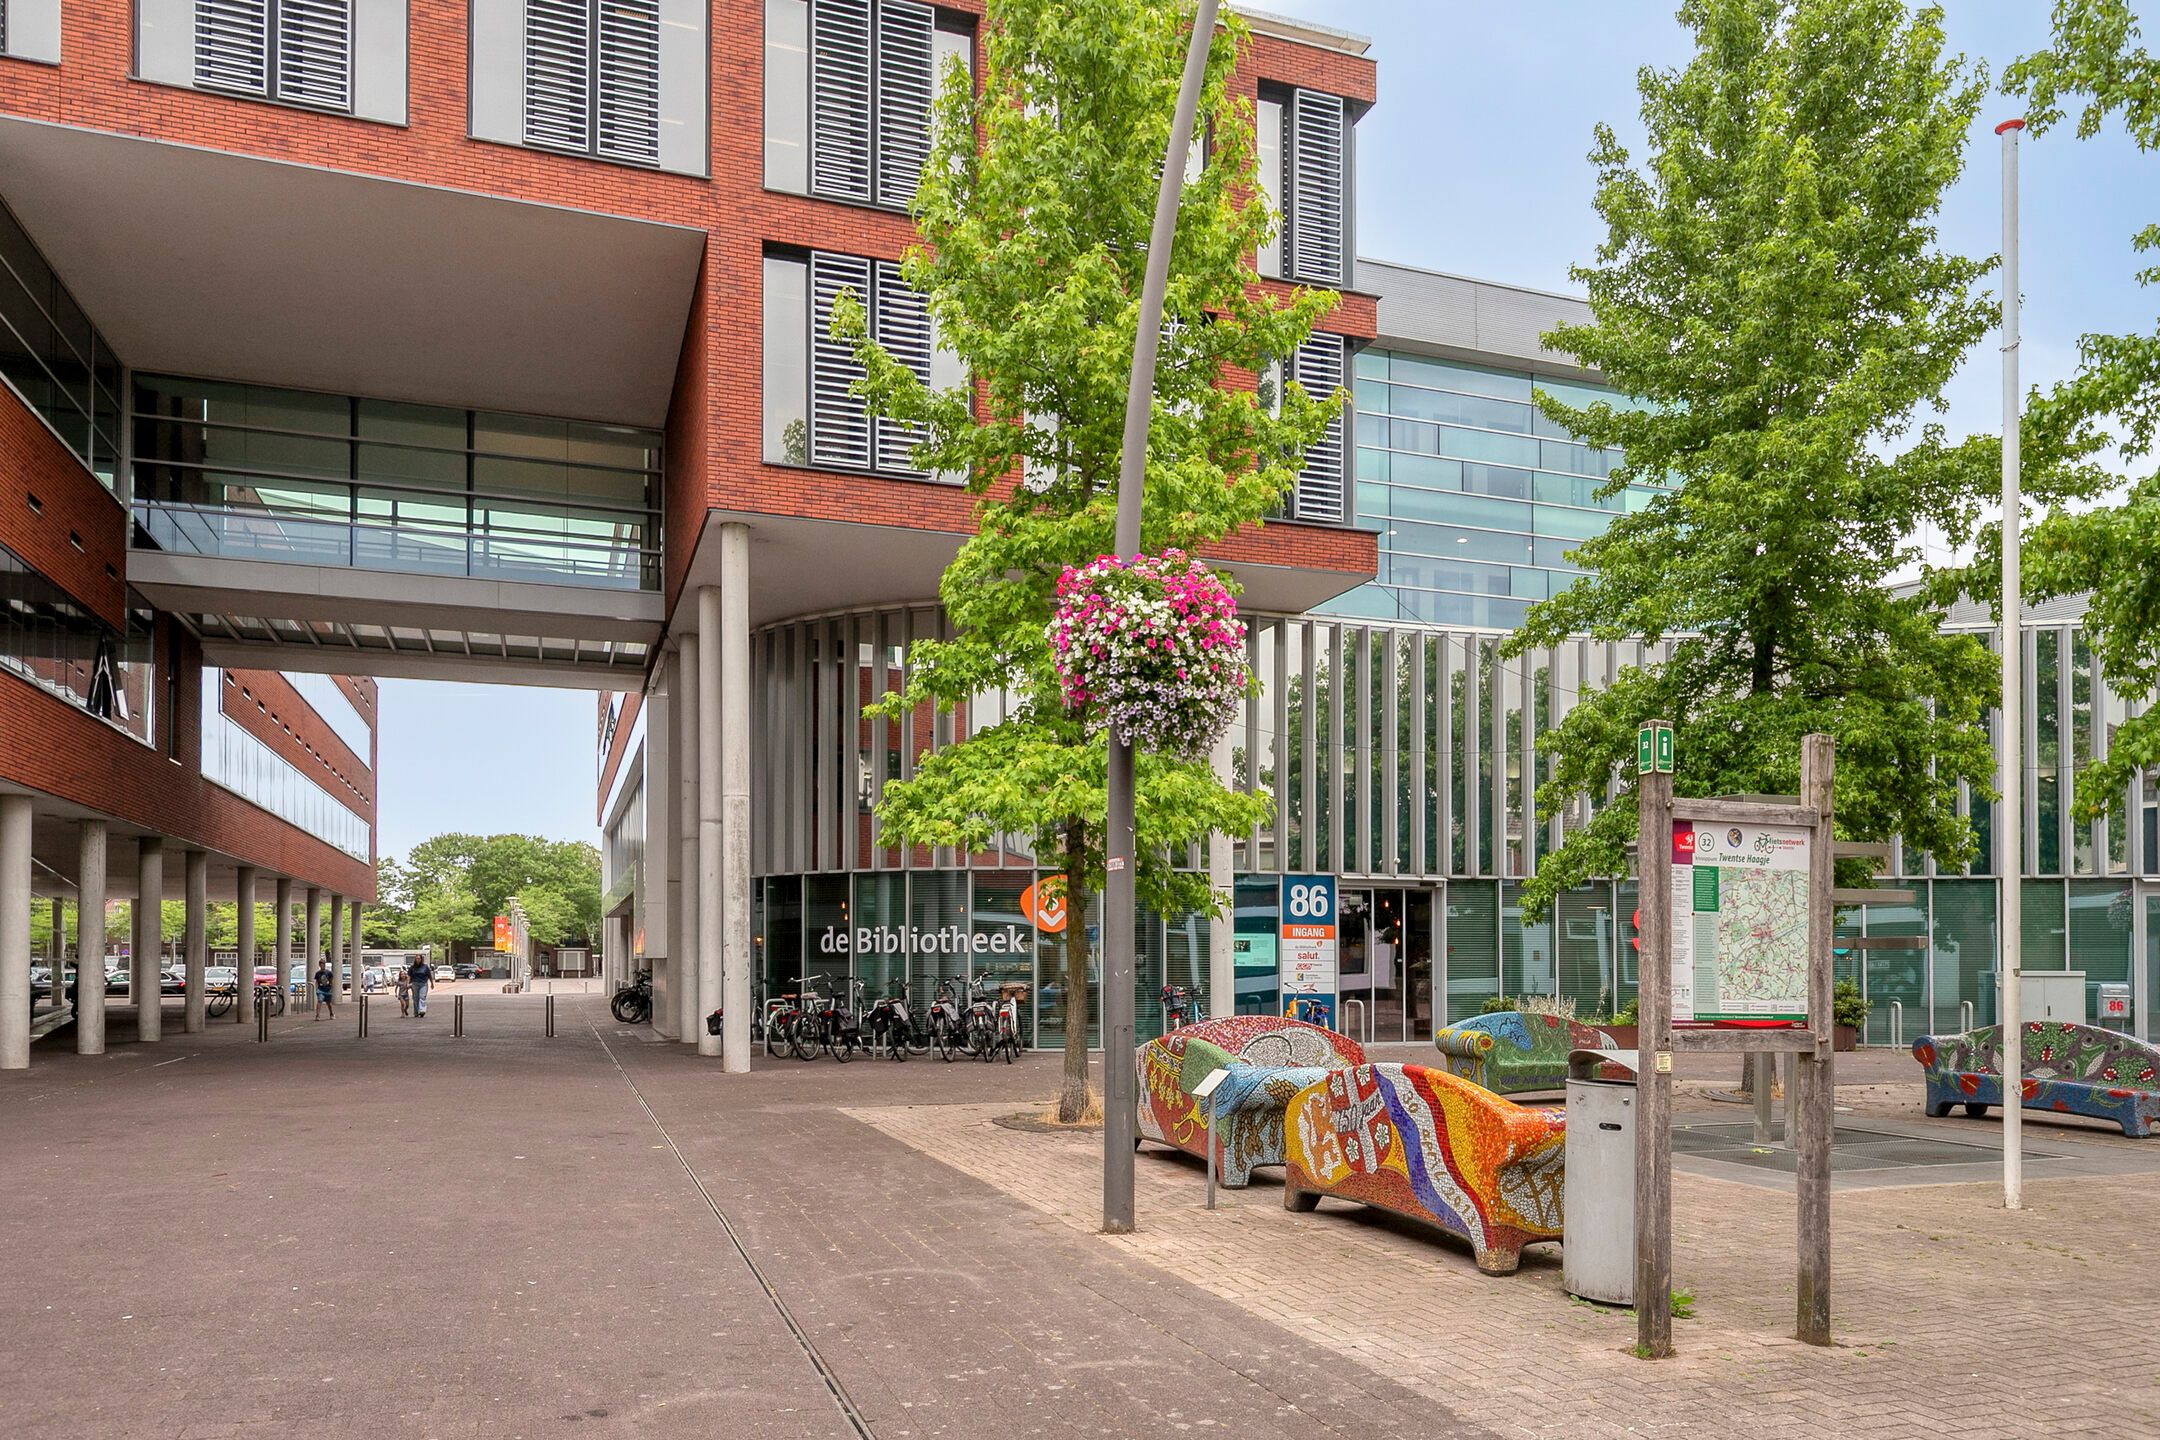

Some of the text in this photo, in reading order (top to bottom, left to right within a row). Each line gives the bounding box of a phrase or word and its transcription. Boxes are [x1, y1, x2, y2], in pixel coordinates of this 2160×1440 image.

[1702, 838, 1711, 847] 32
[1719, 852, 1745, 863] Twentse
[1746, 854, 1770, 866] Haagje
[1290, 885, 1328, 917] 86
[1292, 927, 1325, 937] INGANG
[820, 925, 1026, 954] de Bibliotheek
[2109, 1000, 2124, 1012] 86
